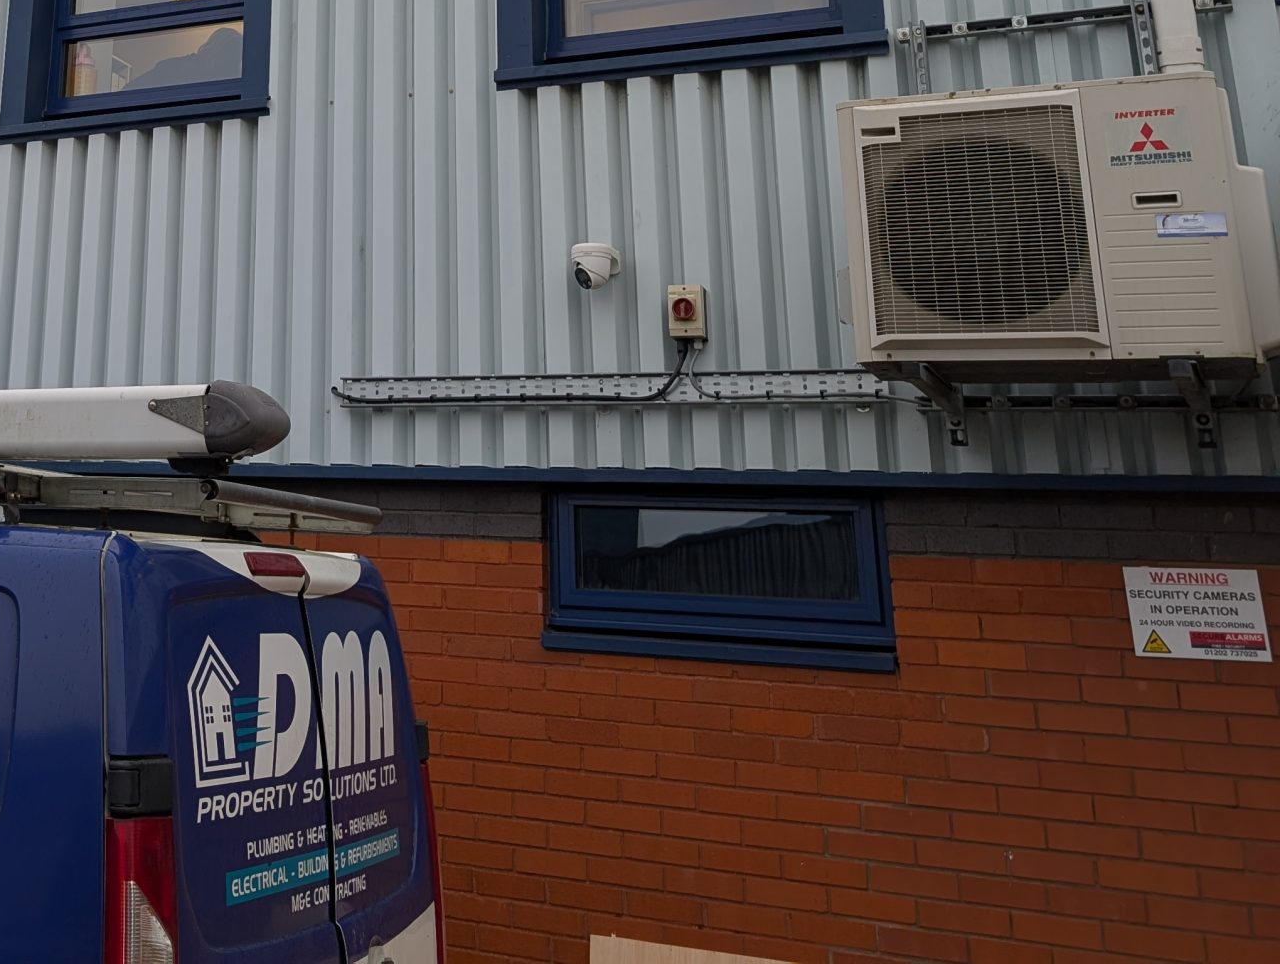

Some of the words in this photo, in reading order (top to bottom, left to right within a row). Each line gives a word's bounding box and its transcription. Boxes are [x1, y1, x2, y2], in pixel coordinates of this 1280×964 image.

[1114, 108, 1175, 119] INVERTER
[1110, 151, 1192, 163] MITSUBISHI
[1149, 571, 1229, 585] WARNING
[1129, 589, 1189, 600] SECURITY
[1193, 591, 1256, 602] CAMERAS
[1150, 605, 1162, 614] IN
[1166, 605, 1239, 616] OPERATION
[1139, 619, 1149, 627] 24
[1150, 619, 1175, 627] HOUR
[1176, 620, 1202, 628] VIDEO
[1204, 621, 1255, 629] RECORDING
[1225, 633, 1263, 642] ALARMS
[253, 630, 396, 780] DMA
[196, 782, 298, 823] PROPERTY
[303, 768, 376, 804] SOLUTIONS
[380, 766, 397, 786] LTD.
[247, 833, 295, 860] PLUMBING
[297, 831, 303, 848] &
[306, 823, 343, 845] HEATNG
[349, 809, 388, 835] RENEWABLES
[232, 866, 288, 897] ELECTRICAL
[341, 852, 347, 868] &
[348, 834, 398, 866] REFURBISHMENTS
[291, 889, 311, 913] M&E
[314, 874, 366, 905] CONTRACTING
